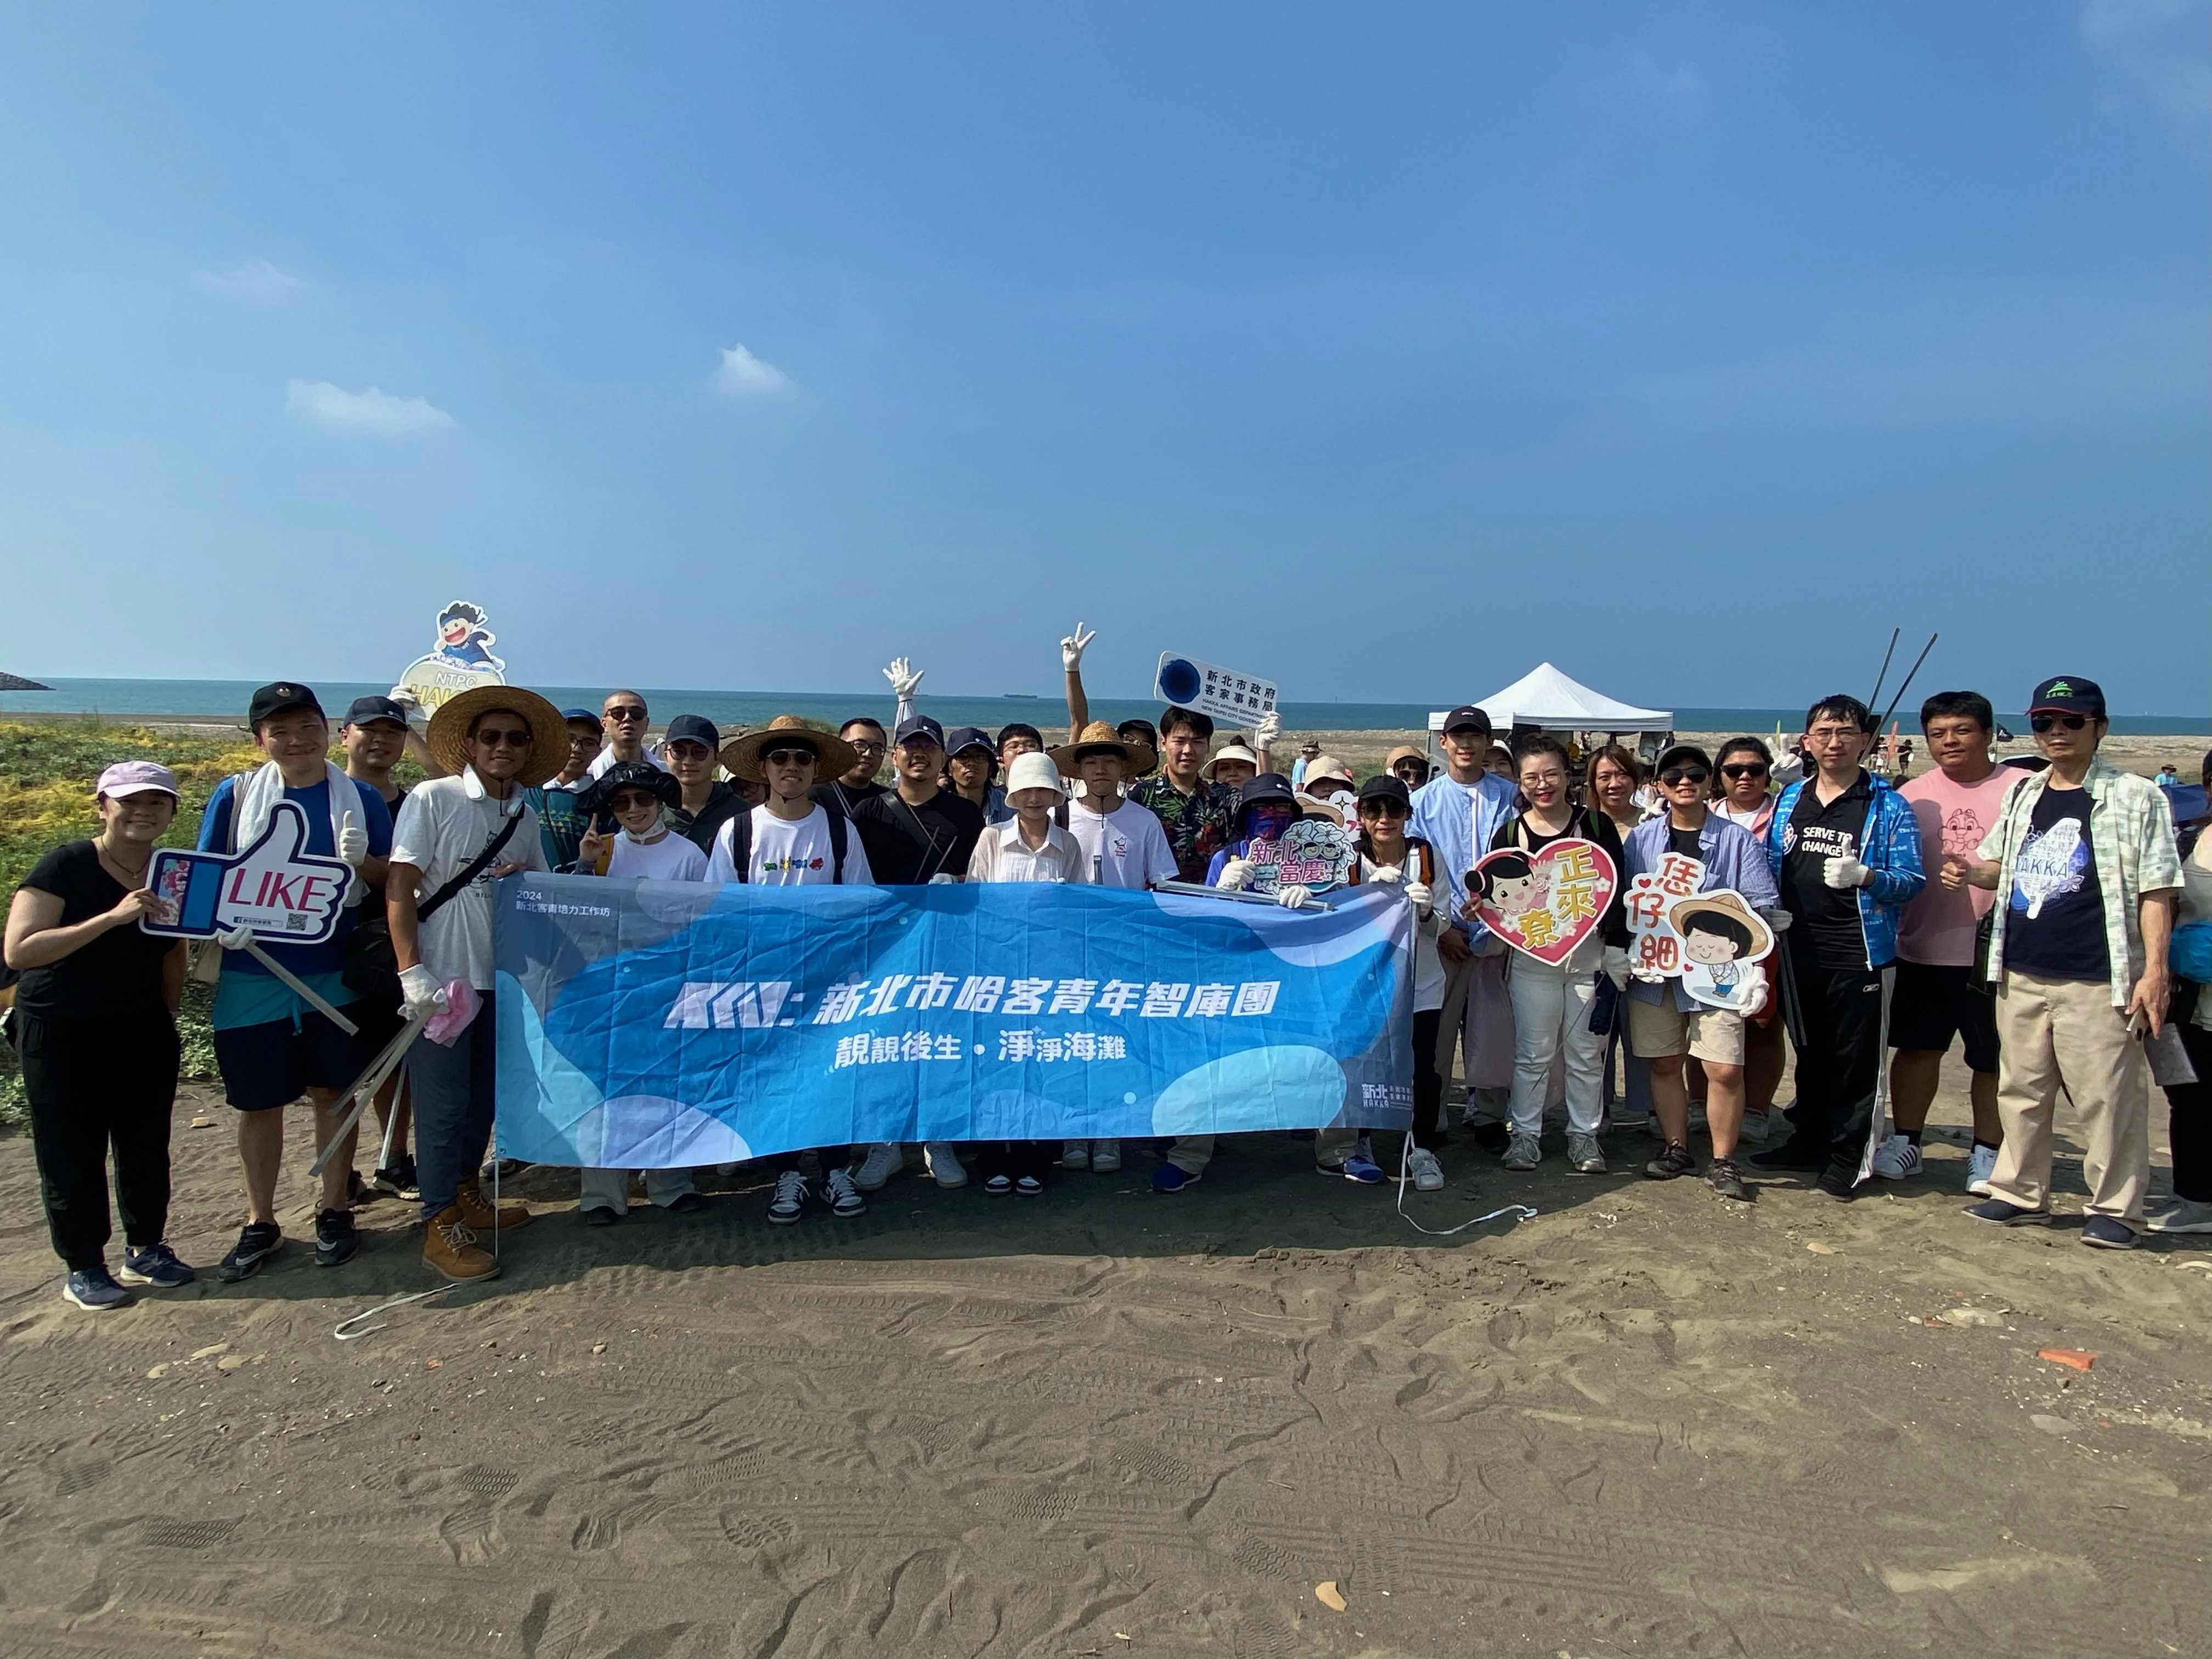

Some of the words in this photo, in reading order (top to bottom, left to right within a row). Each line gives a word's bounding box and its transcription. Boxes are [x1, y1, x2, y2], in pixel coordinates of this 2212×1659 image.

[435, 671, 477, 689] NTPC
[1206, 669, 1276, 699] 新北市政府
[1205, 684, 1273, 712] 客家事務局
[1803, 826, 1836, 841] SERVE
[1837, 831, 1853, 842] TO
[1253, 840, 1300, 865] 新北
[1801, 841, 1842, 857] CHANGE
[1279, 859, 1326, 885] 當慶
[228, 867, 332, 913] LIKE
[516, 890, 543, 900] 2024
[515, 900, 611, 917] 新北客青培力工作坊
[811, 972, 1282, 1025] 新北市哈客青年智庫團
[1362, 1083, 1388, 1099] 新北
[1363, 1099, 1389, 1108] HAKKA
